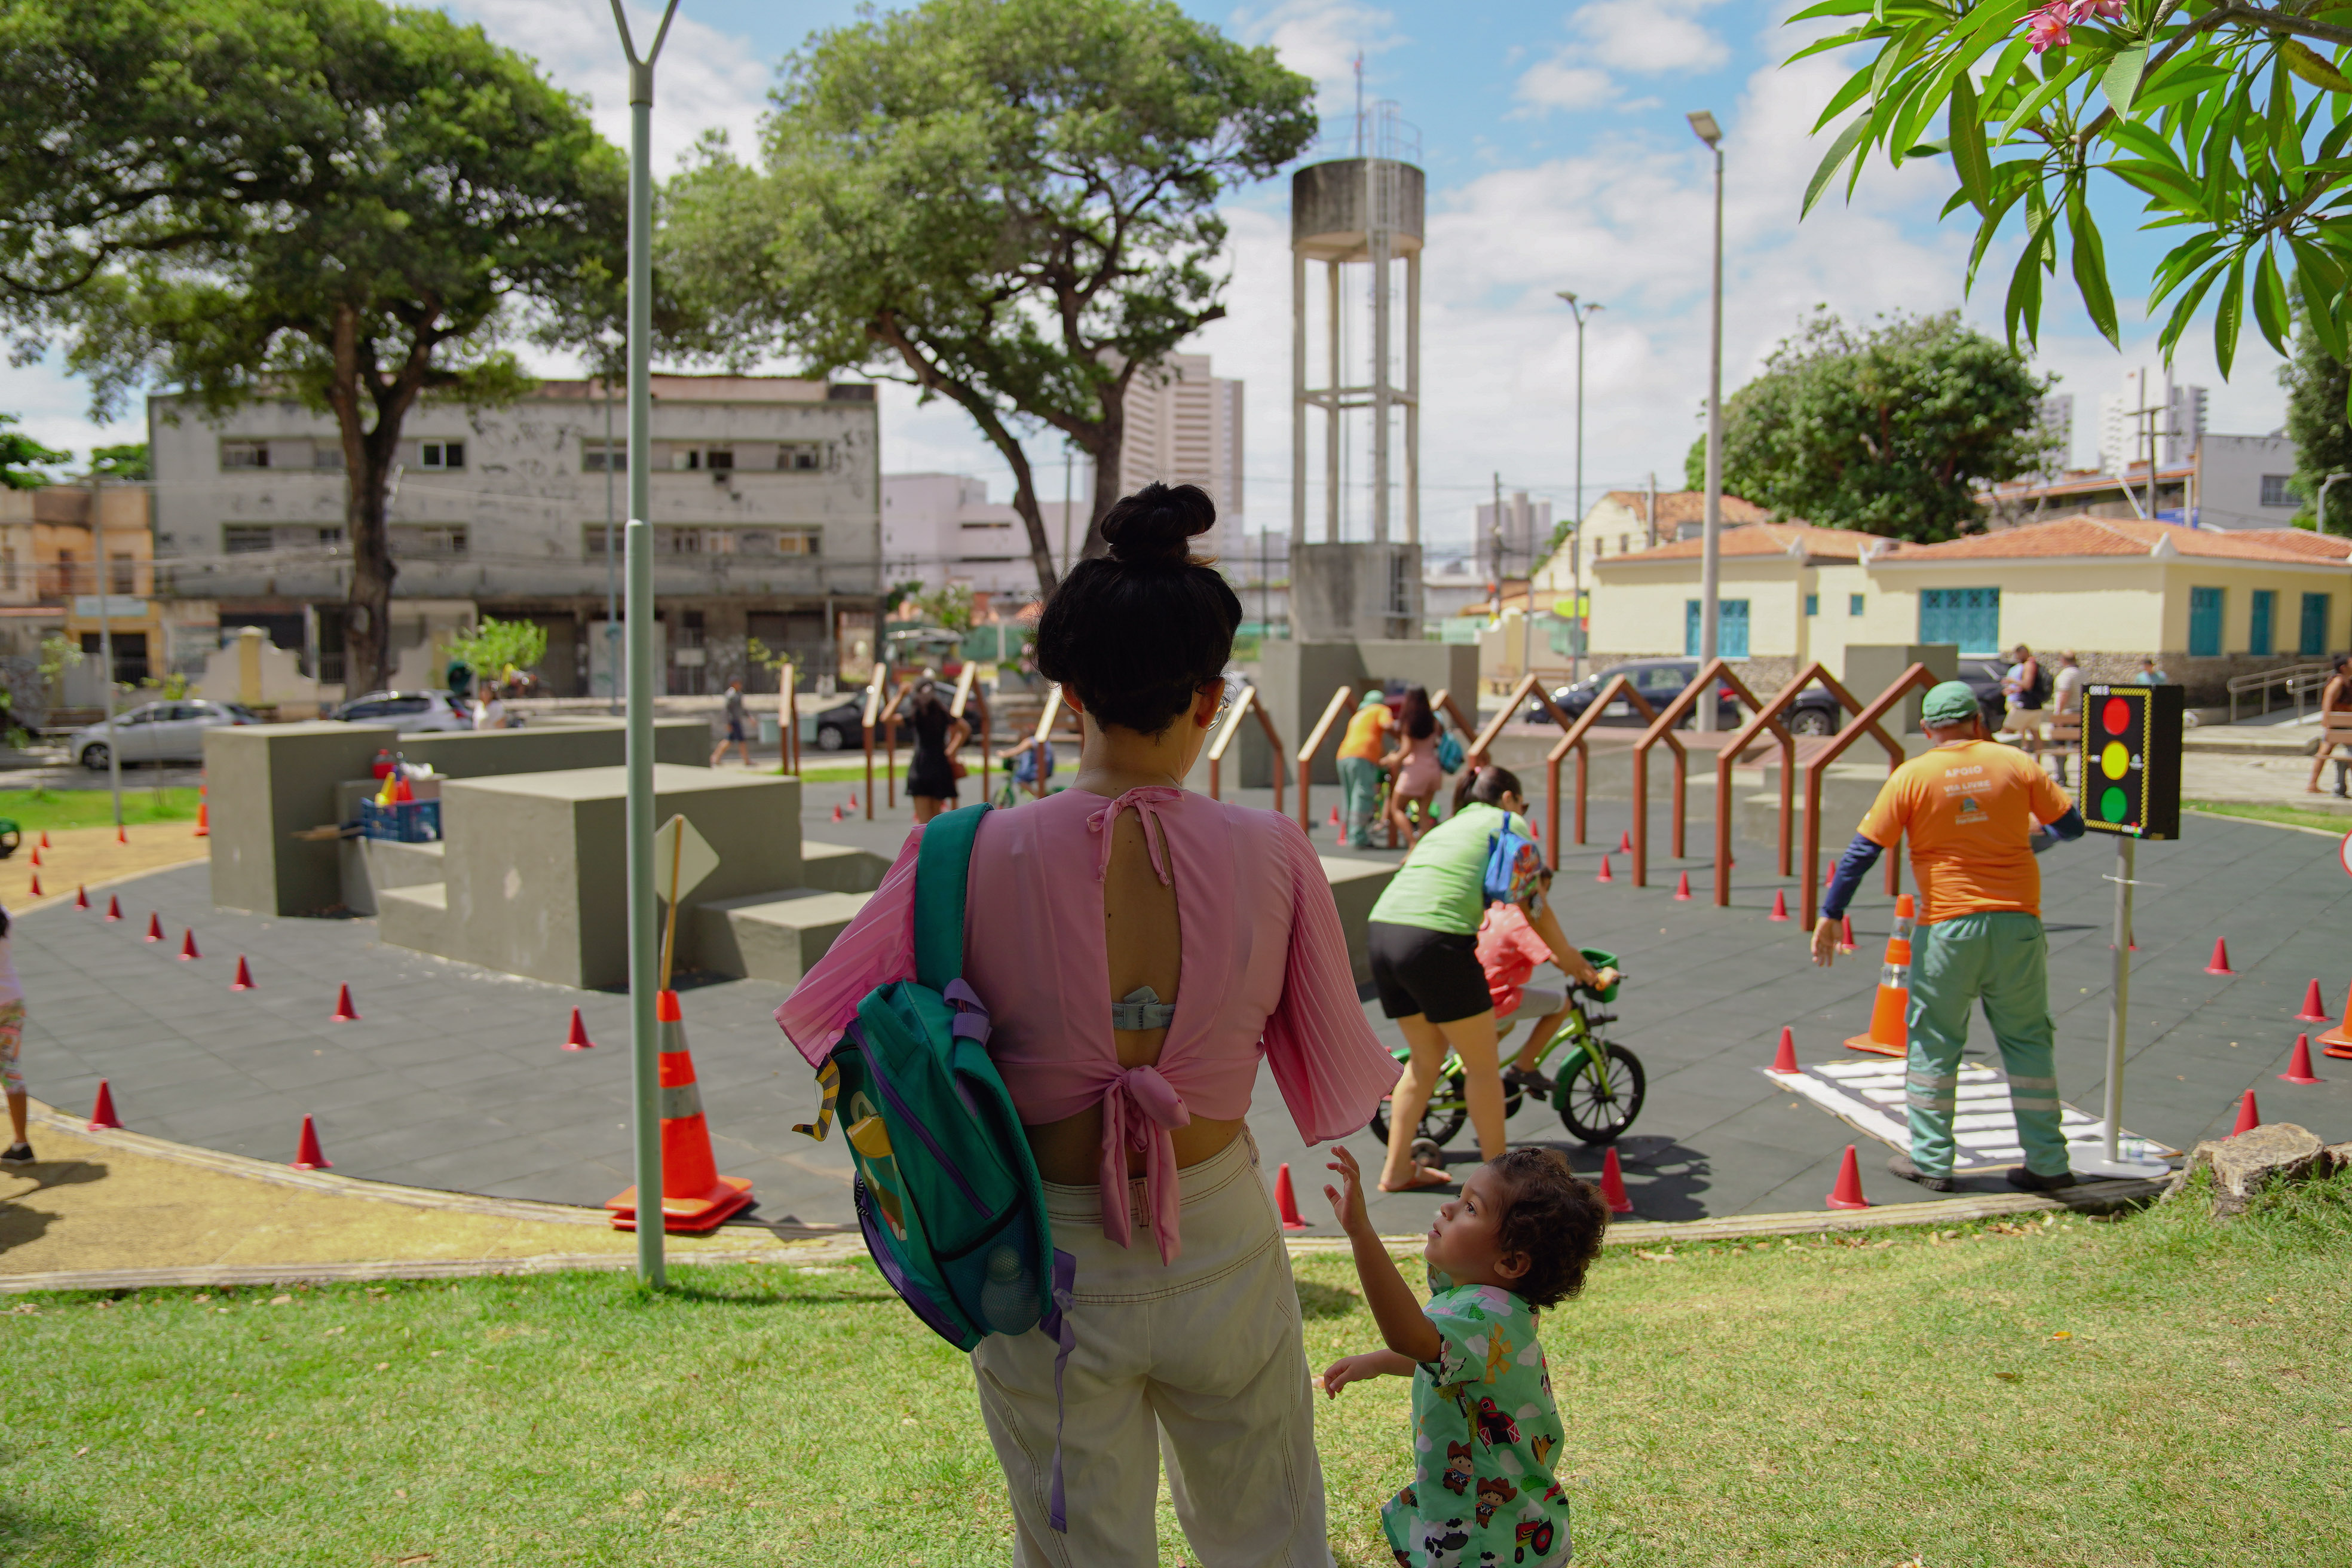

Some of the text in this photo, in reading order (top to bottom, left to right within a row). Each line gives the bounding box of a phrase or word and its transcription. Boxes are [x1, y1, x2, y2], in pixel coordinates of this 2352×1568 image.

[1945, 765, 1983, 778] APOIO
[1943, 779, 1992, 792] VIA LIVRE
